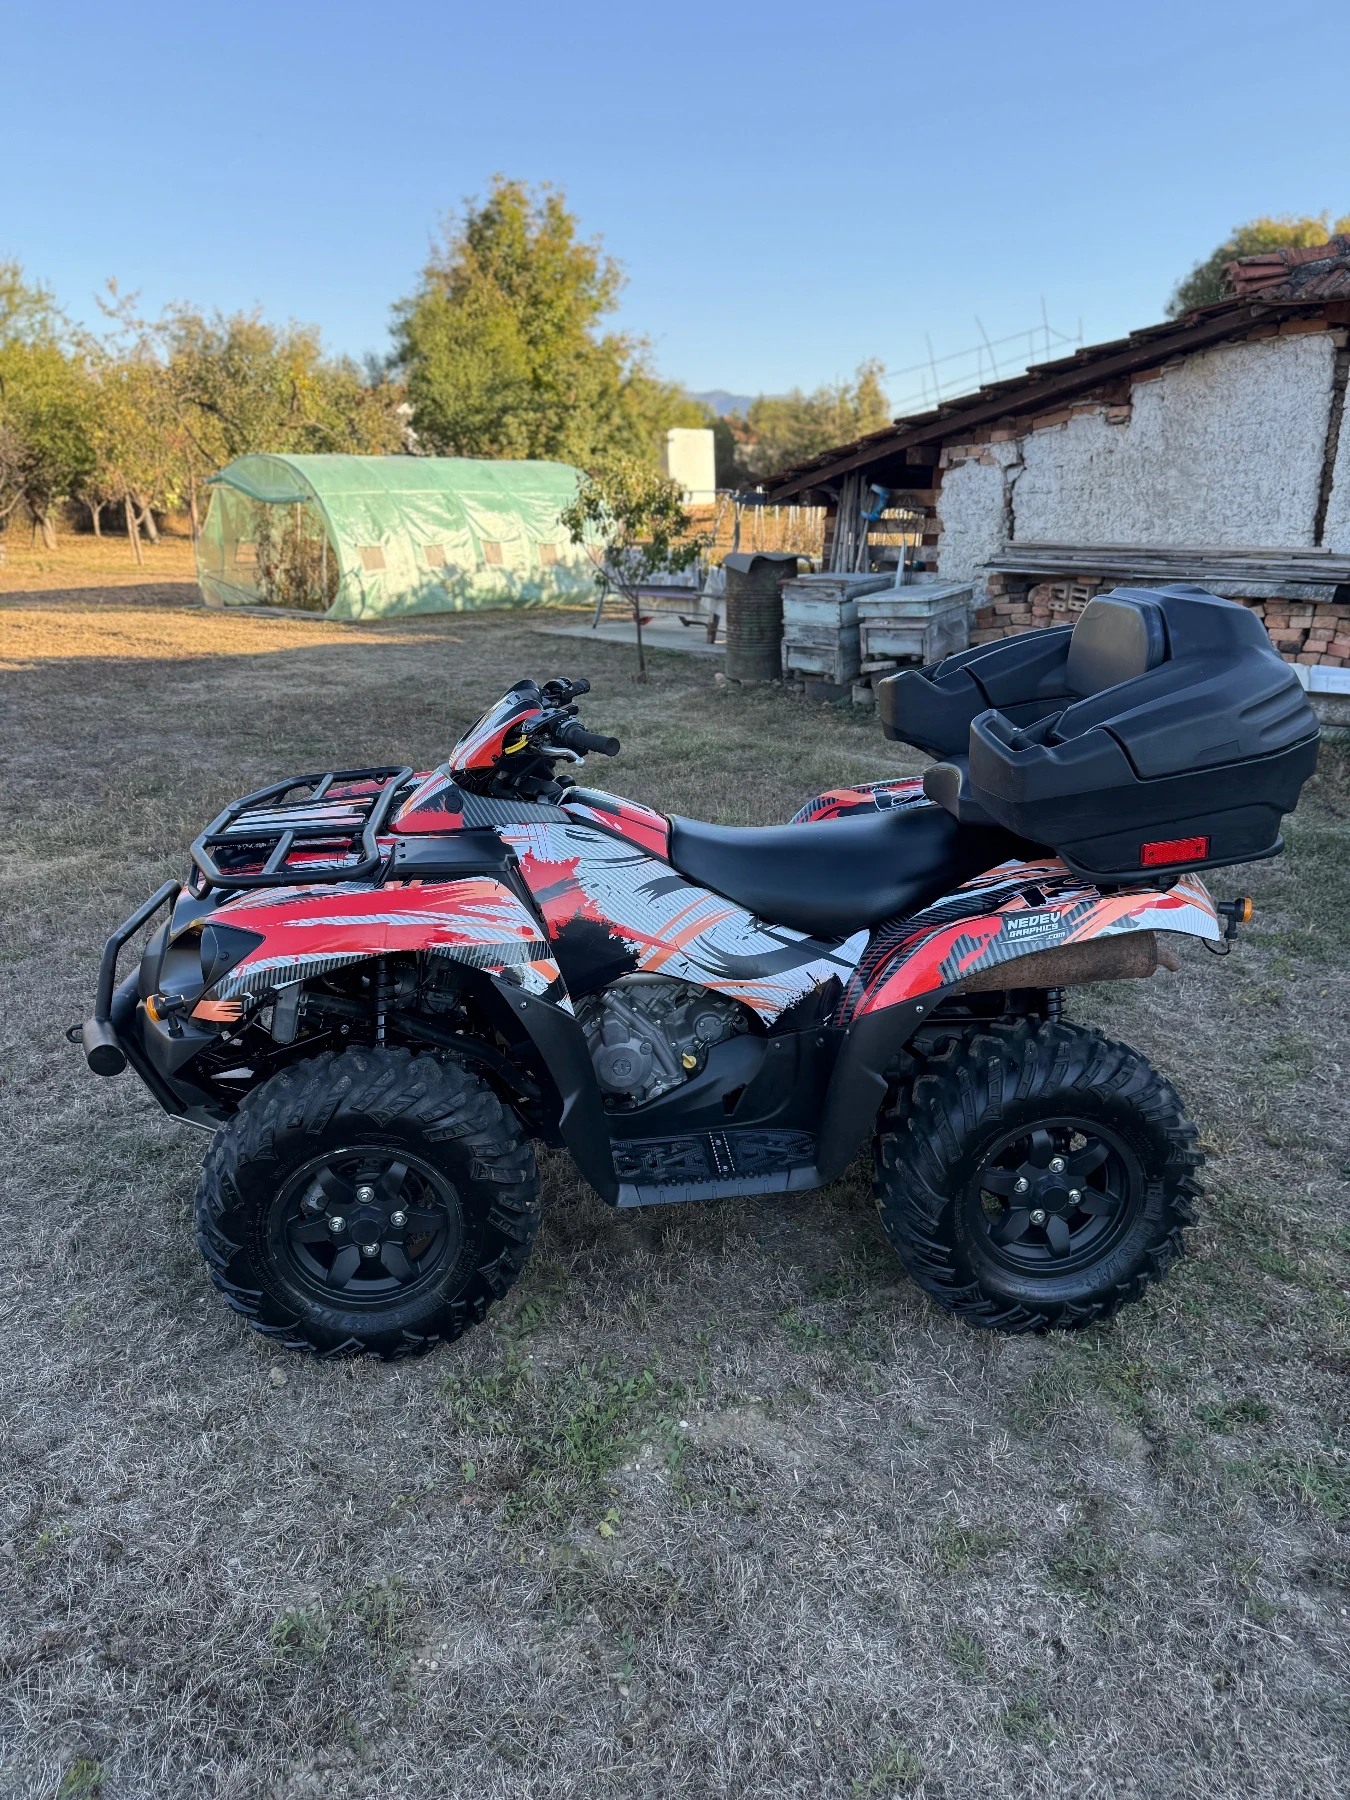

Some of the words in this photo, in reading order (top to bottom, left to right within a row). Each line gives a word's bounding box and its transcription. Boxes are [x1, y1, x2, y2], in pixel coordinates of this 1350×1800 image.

[1008, 911, 1061, 930] NEDEV
[1009, 923, 1059, 938] GRAPHICS
[1119, 1221, 1156, 1262] CROSS
